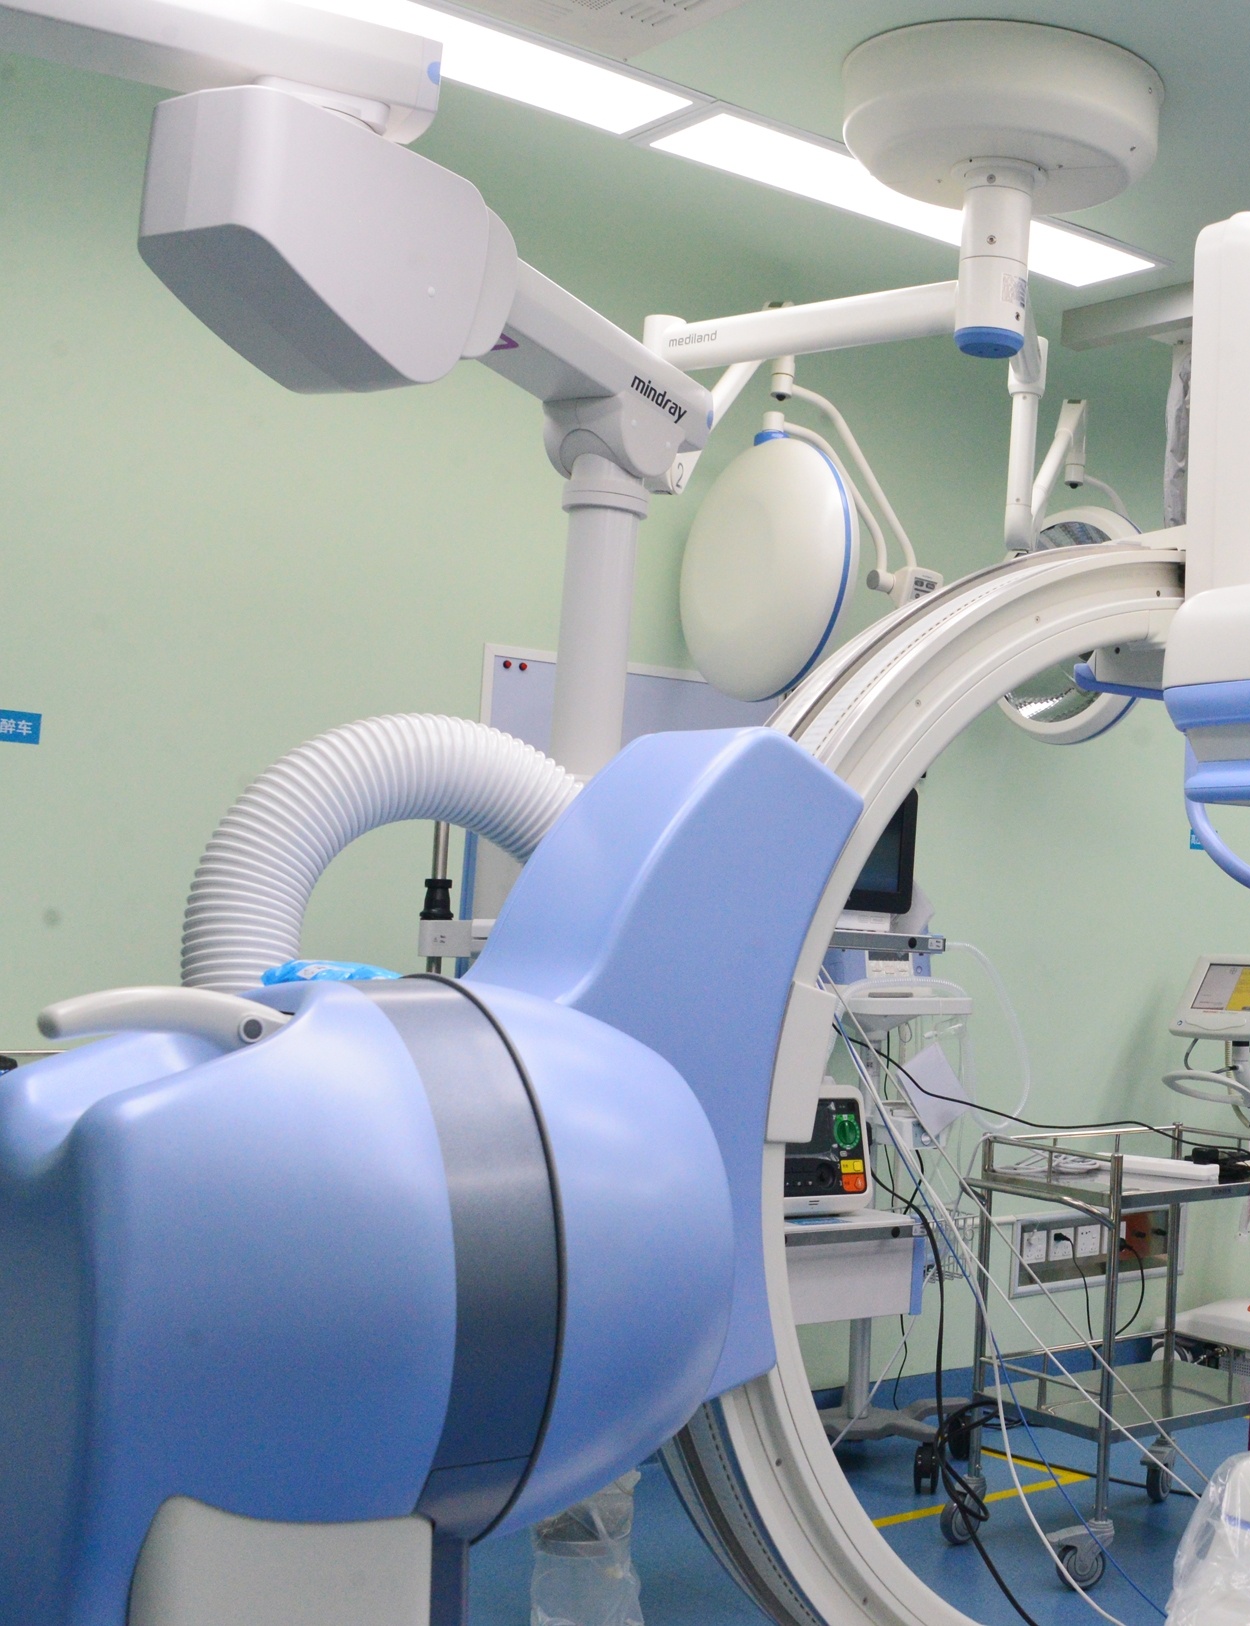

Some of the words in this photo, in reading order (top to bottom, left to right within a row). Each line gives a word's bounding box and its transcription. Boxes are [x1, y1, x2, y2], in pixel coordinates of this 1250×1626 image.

[668, 330, 718, 348] mediland
[630, 375, 688, 424] mindray
[675, 462, 685, 489] 2
[0, 719, 32, 735] 醉车
